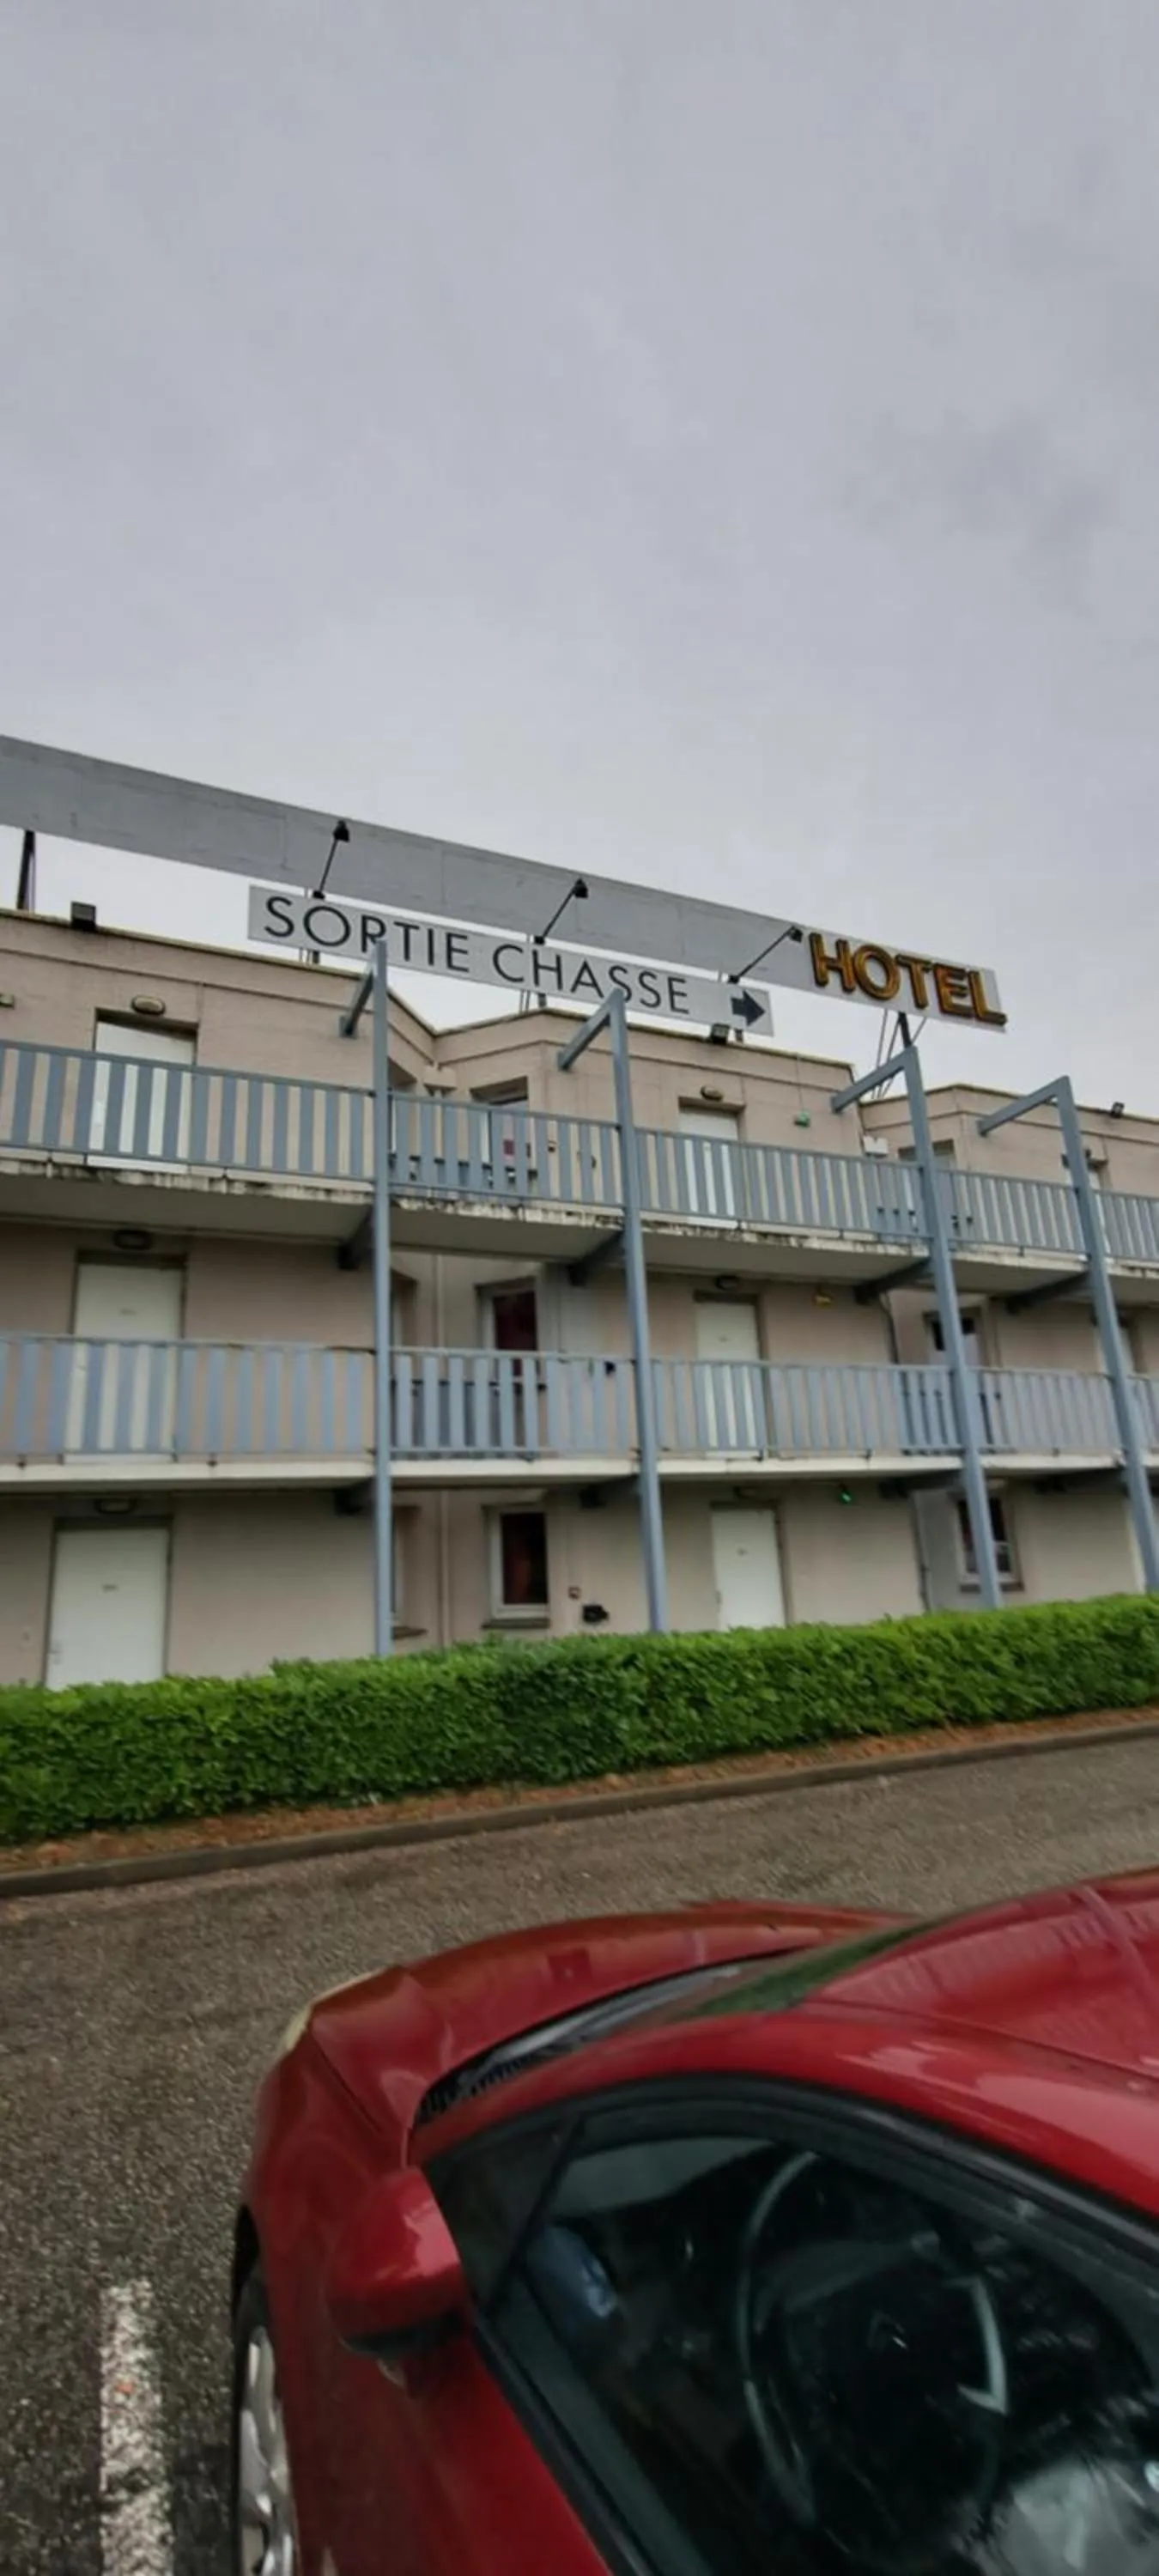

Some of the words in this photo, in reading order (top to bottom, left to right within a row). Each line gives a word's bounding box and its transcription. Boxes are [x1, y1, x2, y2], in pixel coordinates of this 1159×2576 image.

[264, 896, 470, 972] SORTIE
[492, 944, 690, 1015] CHASSE
[809, 932, 1007, 1025] HOTEL
